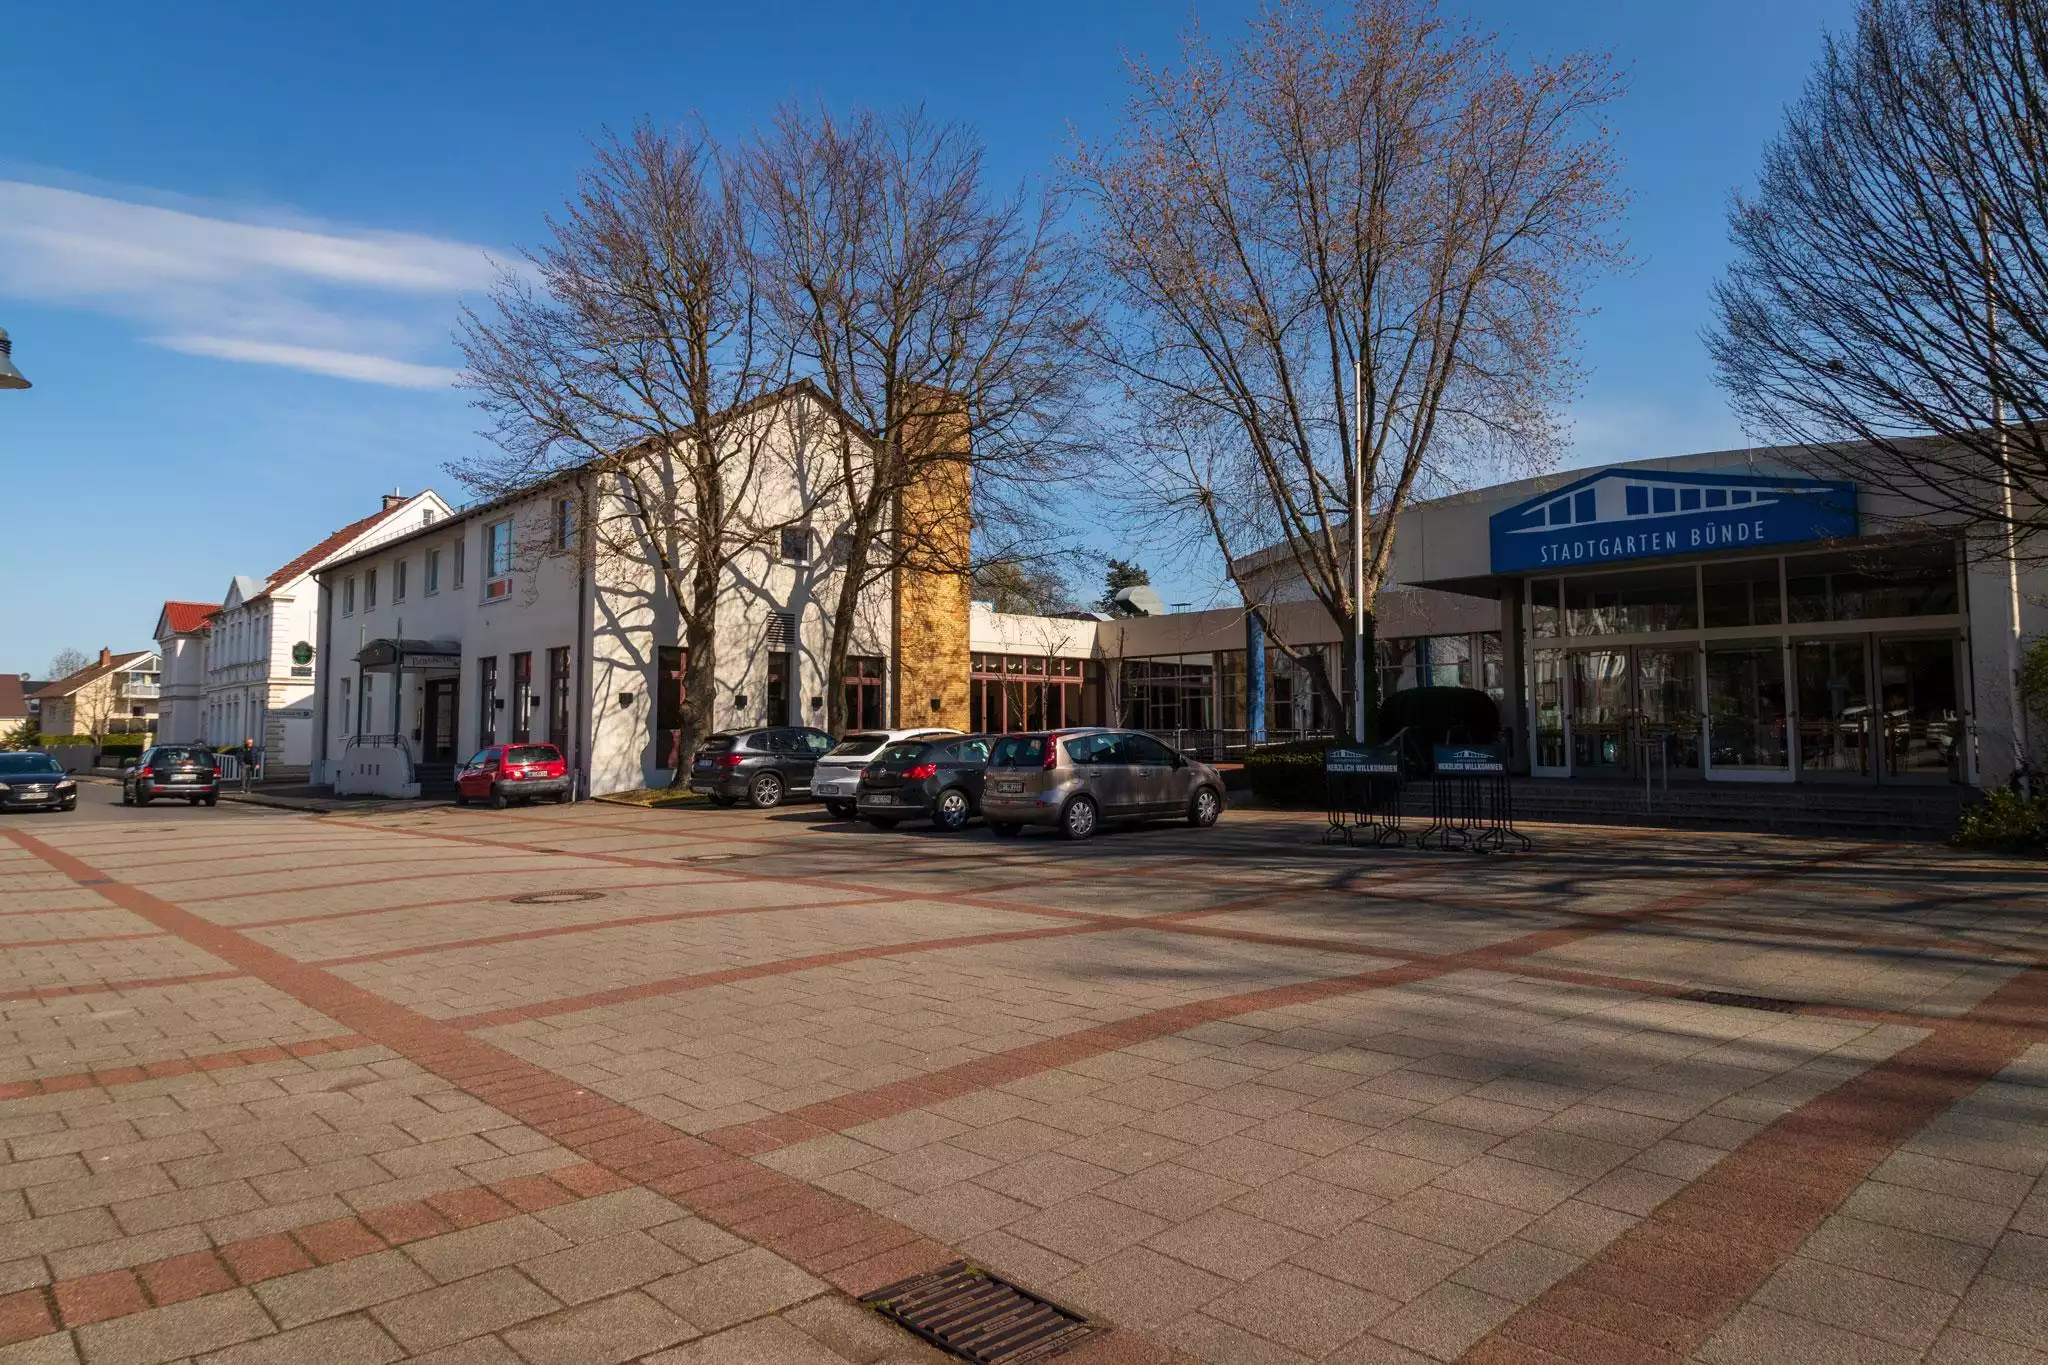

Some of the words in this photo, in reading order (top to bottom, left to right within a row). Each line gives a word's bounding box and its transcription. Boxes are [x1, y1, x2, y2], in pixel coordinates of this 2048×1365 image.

[1540, 530, 1677, 563] STADTGARTEN
[1691, 520, 1765, 547] BÜNDE
[1326, 763, 1355, 772] HERZLICH
[1356, 764, 1398, 773] WILLKOMMEN
[1438, 762, 1464, 771] HERZLICH
[1464, 763, 1503, 771] WILLKOMMEN
